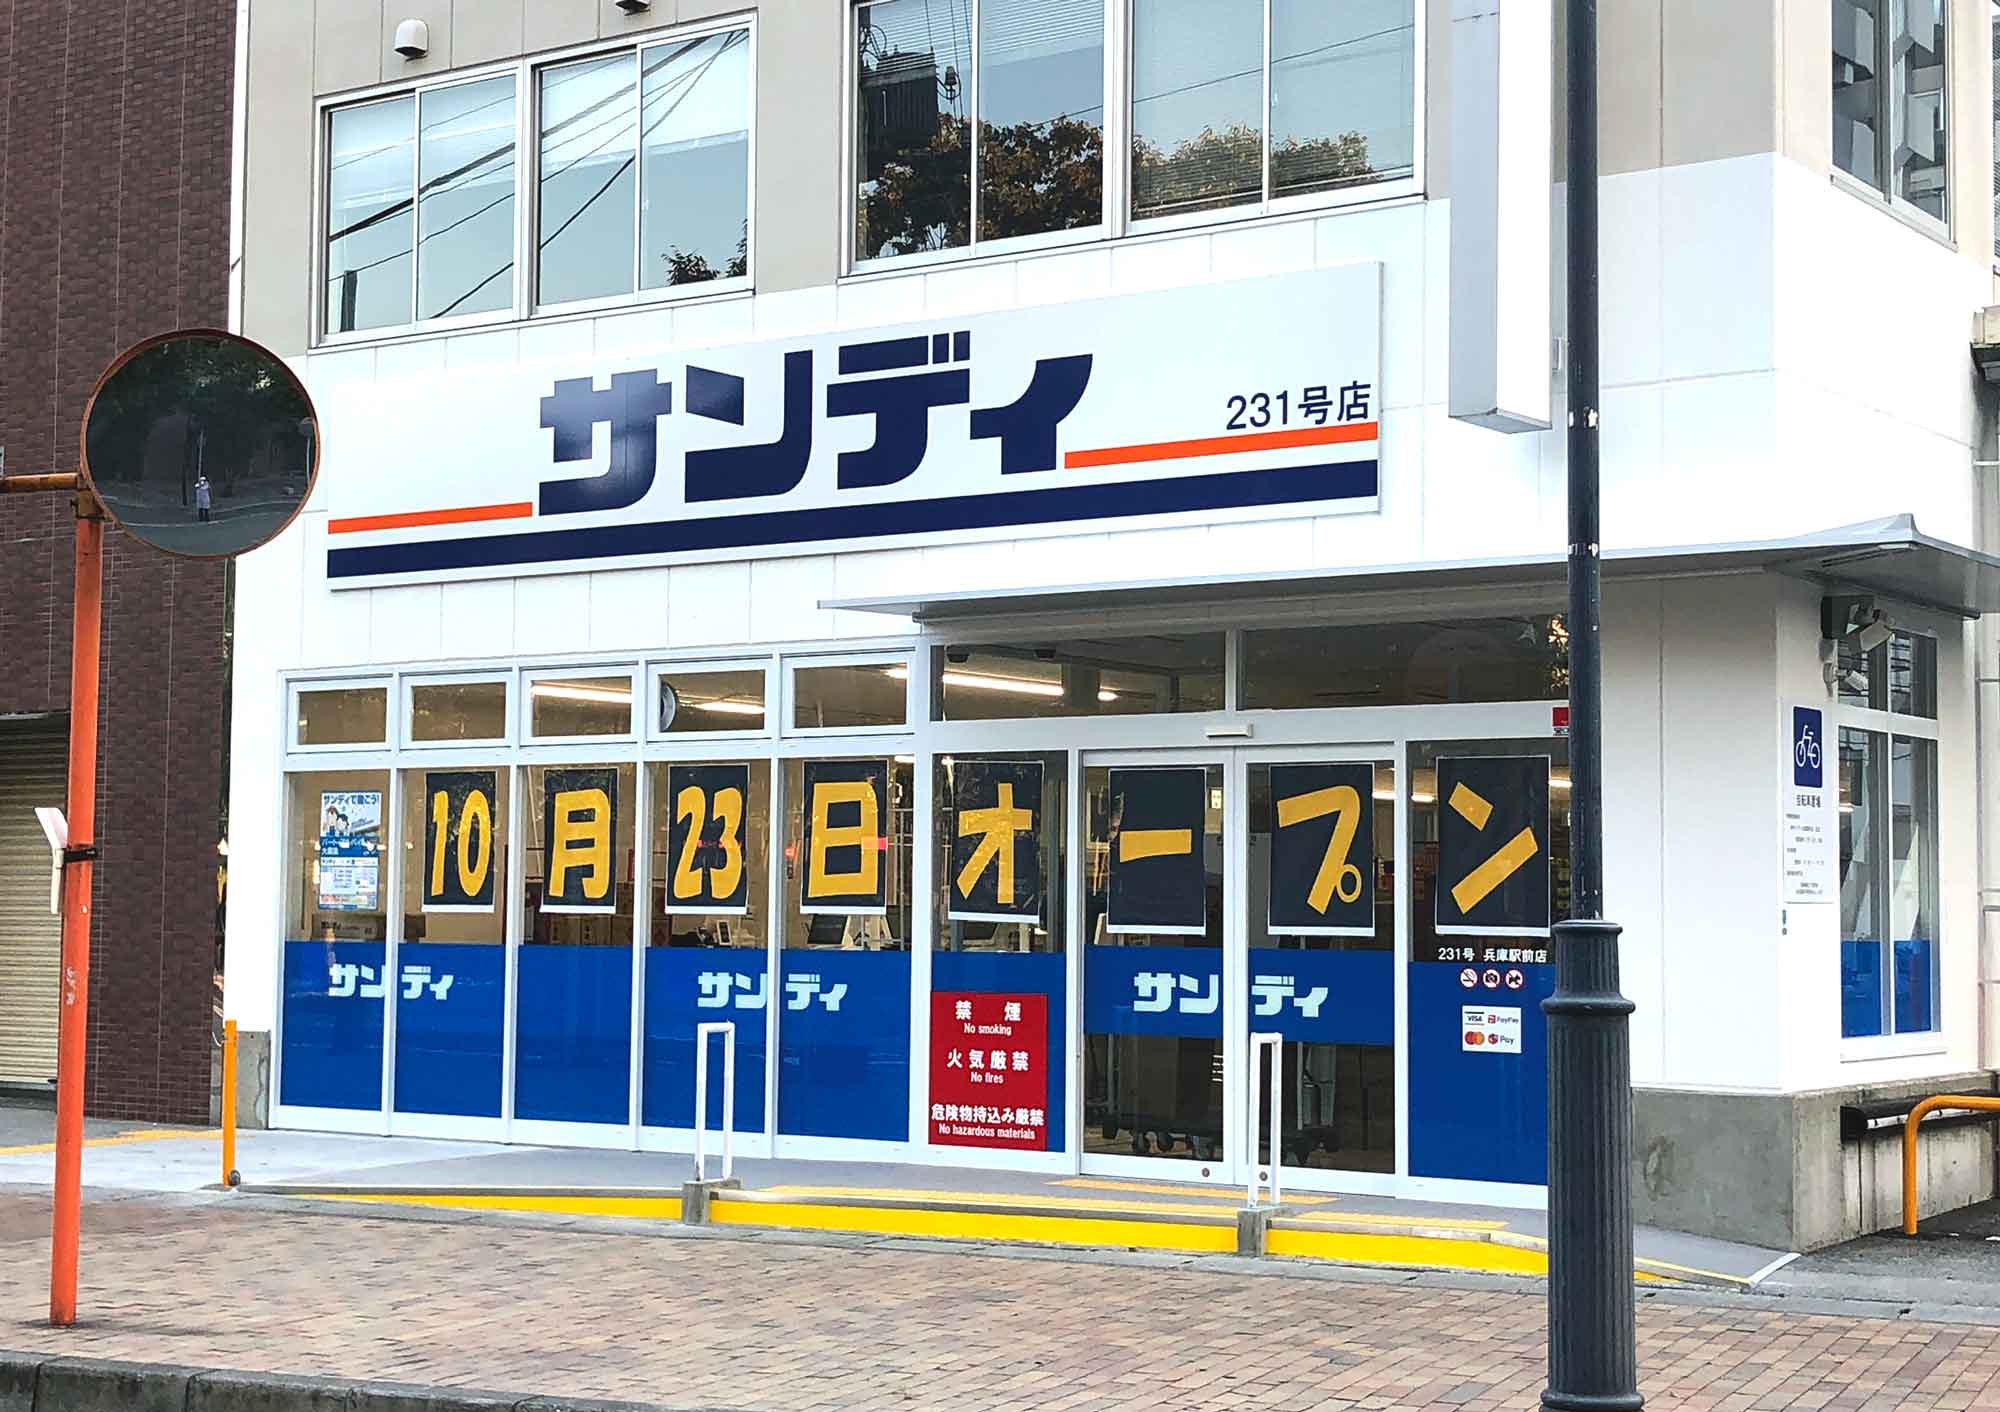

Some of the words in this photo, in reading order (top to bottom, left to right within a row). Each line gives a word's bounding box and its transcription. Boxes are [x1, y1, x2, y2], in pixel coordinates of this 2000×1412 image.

[1226, 380, 1371, 431] 231号店
[540, 330, 1093, 516] サンディ
[1438, 947, 1475, 962] 231号
[1483, 948, 1547, 963] 兵庫駅前店
[698, 971, 847, 1011] サンディ
[1133, 972, 1328, 1018] サンディ
[964, 1023, 975, 1034] No
[978, 1024, 1012, 1036] smoking
[970, 1072, 983, 1083] No
[985, 1072, 1004, 1084] fires
[931, 1103, 1044, 1126] 危険物持込み厳禁
[939, 1123, 951, 1135] No
[952, 1124, 995, 1137] hazardous
[997, 1127, 1035, 1140] materials
